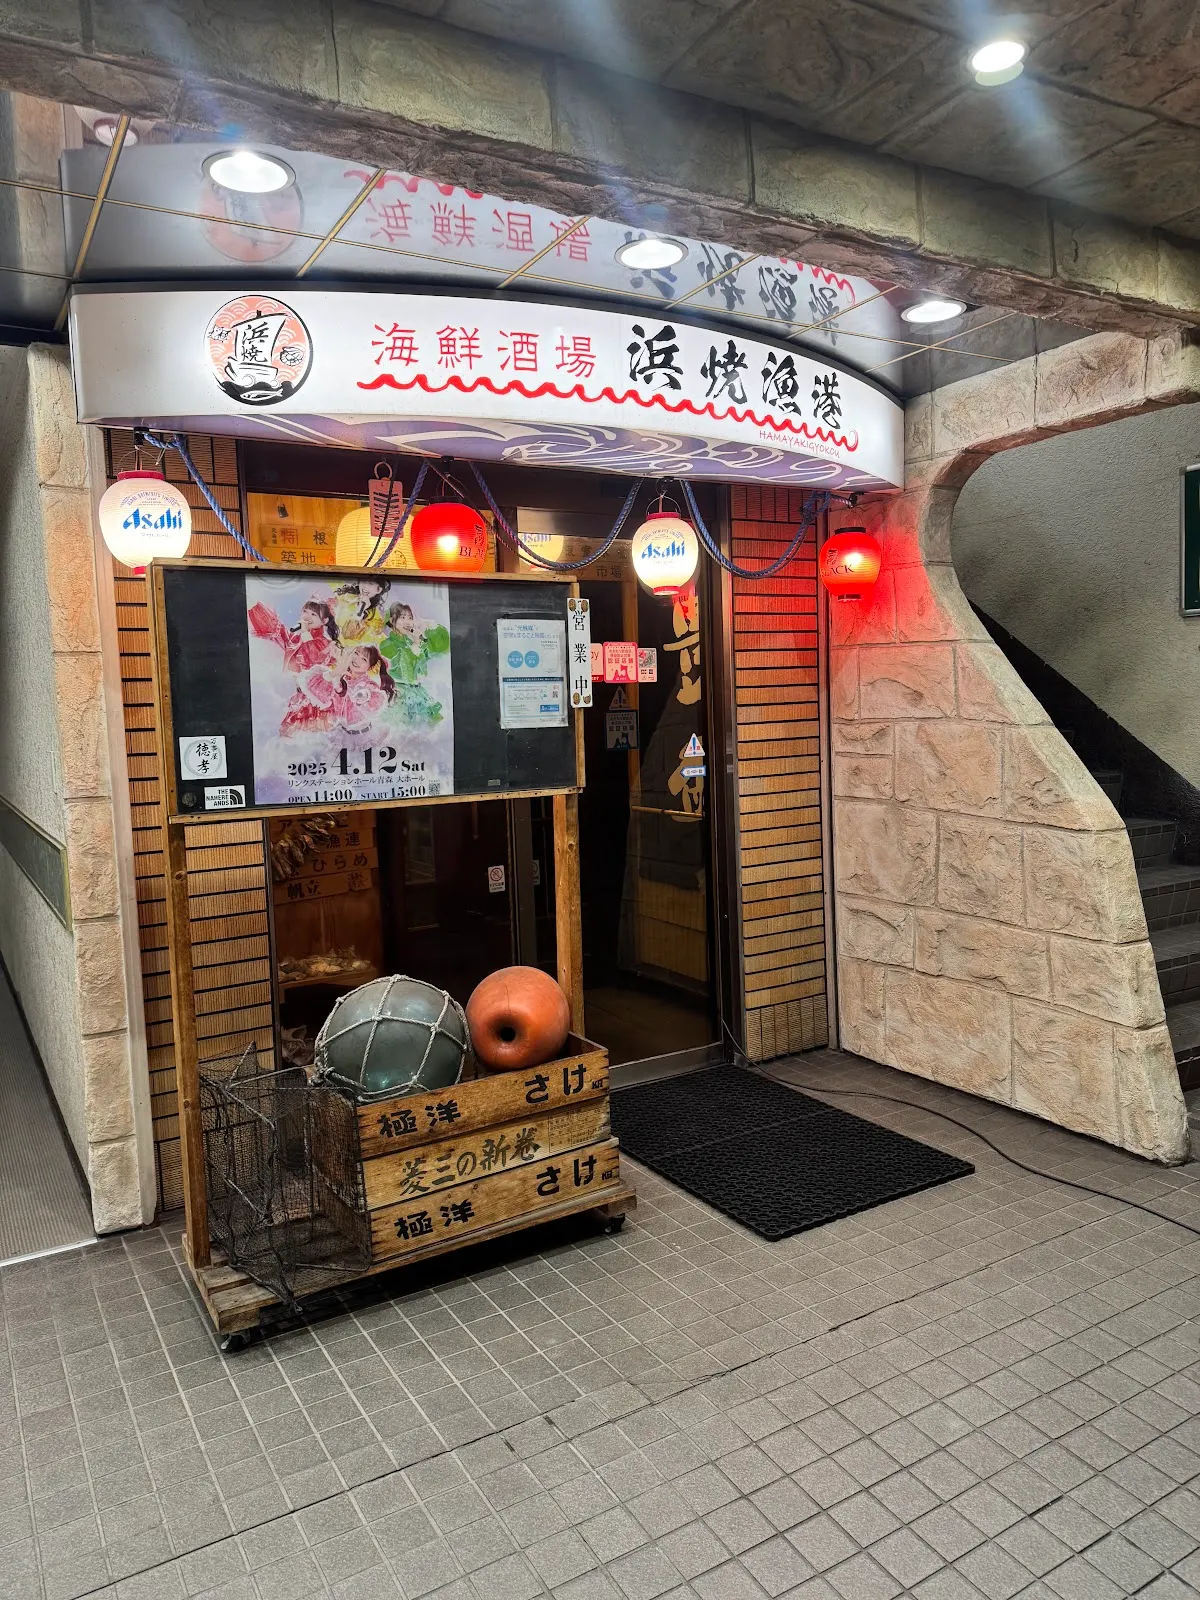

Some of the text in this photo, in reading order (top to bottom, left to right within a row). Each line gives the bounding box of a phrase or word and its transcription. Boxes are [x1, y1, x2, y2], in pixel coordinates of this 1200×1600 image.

[240, 321, 270, 363] 浜焼
[371, 322, 843, 430] 海鮮酒場 浜焼漁港
[759, 430, 840, 458] HAMAYAKIGYOKOU
[122, 507, 183, 530] Asahi
[641, 540, 685, 559] Asahi
[572, 610, 588, 696] 営業中
[287, 746, 425, 776] 2025 4.12 Sat
[360, 791, 388, 799] START
[389, 785, 425, 798] 15:00
[312, 852, 369, 872] ひらめ
[377, 1100, 461, 1137] 極洋
[524, 1063, 587, 1104] さけ
[394, 1199, 475, 1240] 極洋
[536, 1154, 597, 1196] さけ
